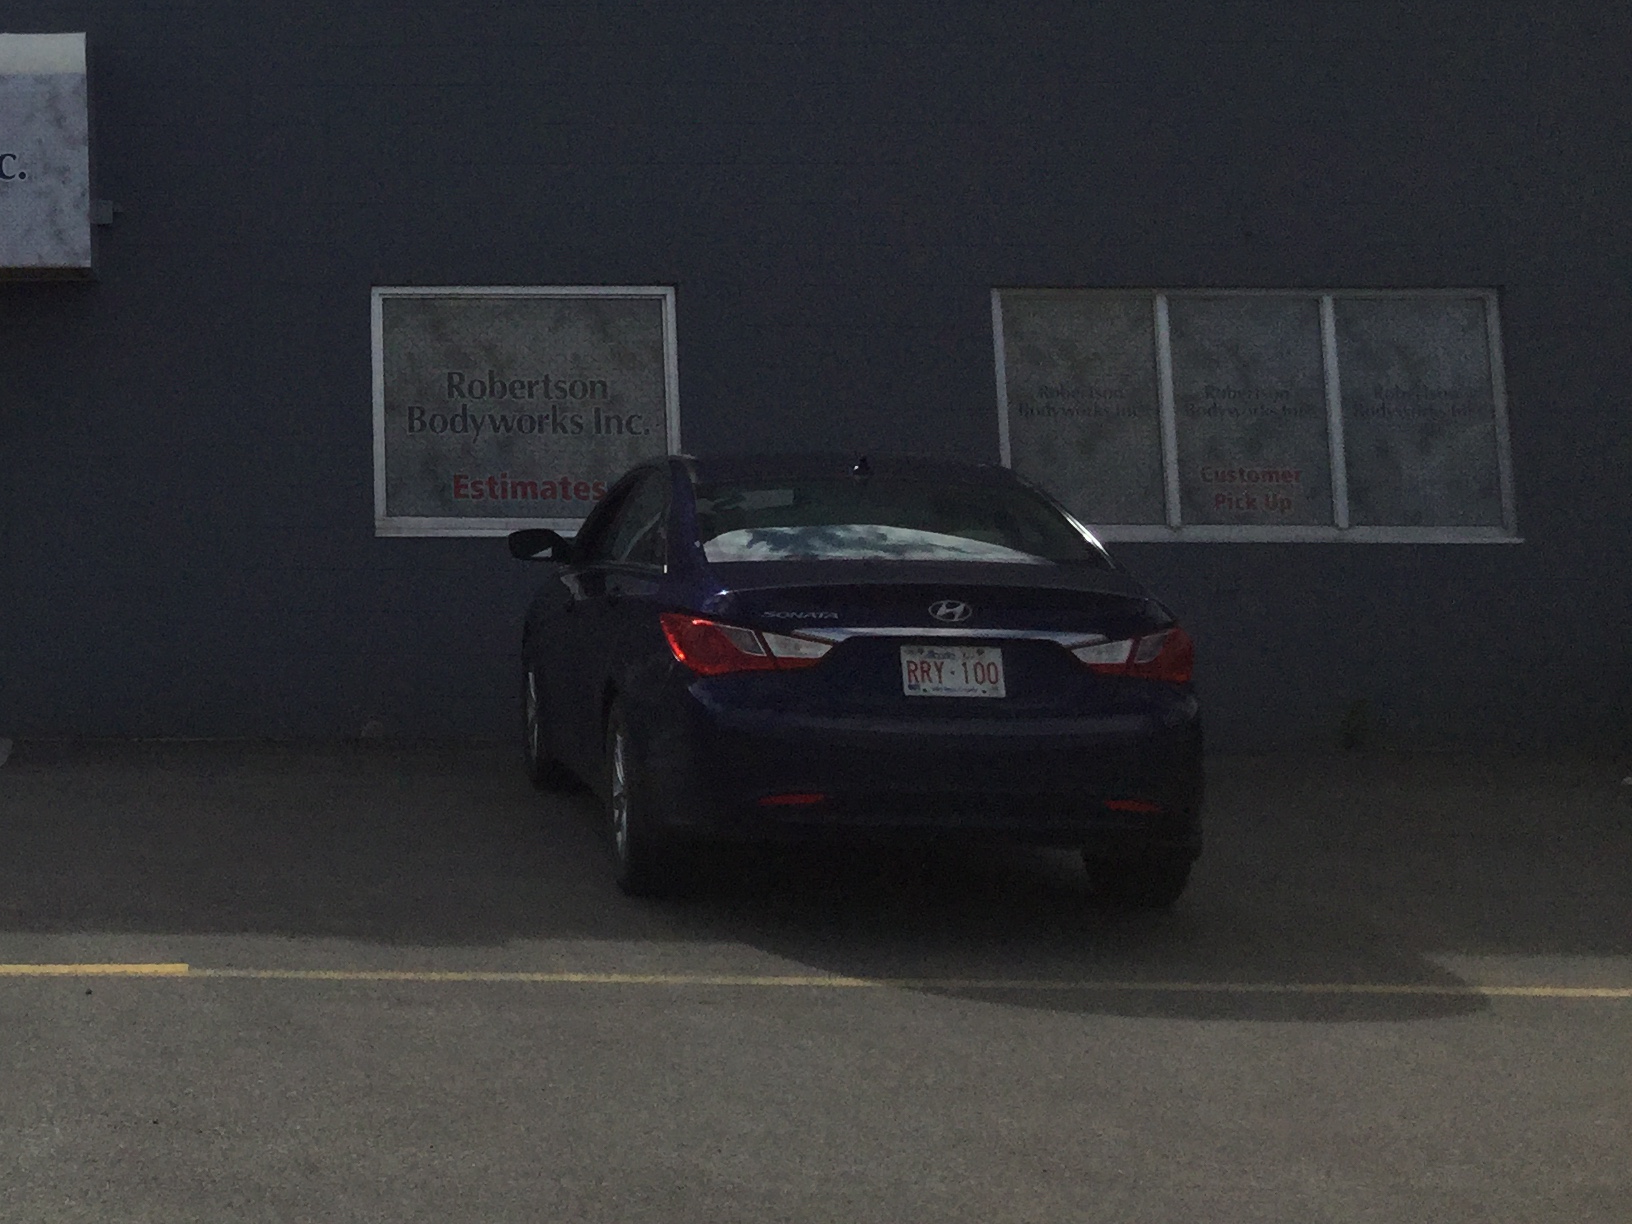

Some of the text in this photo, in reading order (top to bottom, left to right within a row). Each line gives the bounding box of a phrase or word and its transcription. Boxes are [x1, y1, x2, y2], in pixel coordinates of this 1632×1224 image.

[446, 370, 608, 400] Robertson
[406, 403, 650, 444] Bodyworks Inc.
[452, 472, 608, 502] Estimates
[1200, 466, 1303, 483] Customer
[1214, 492, 1293, 514] Pick Up
[761, 610, 839, 620] SONATA
